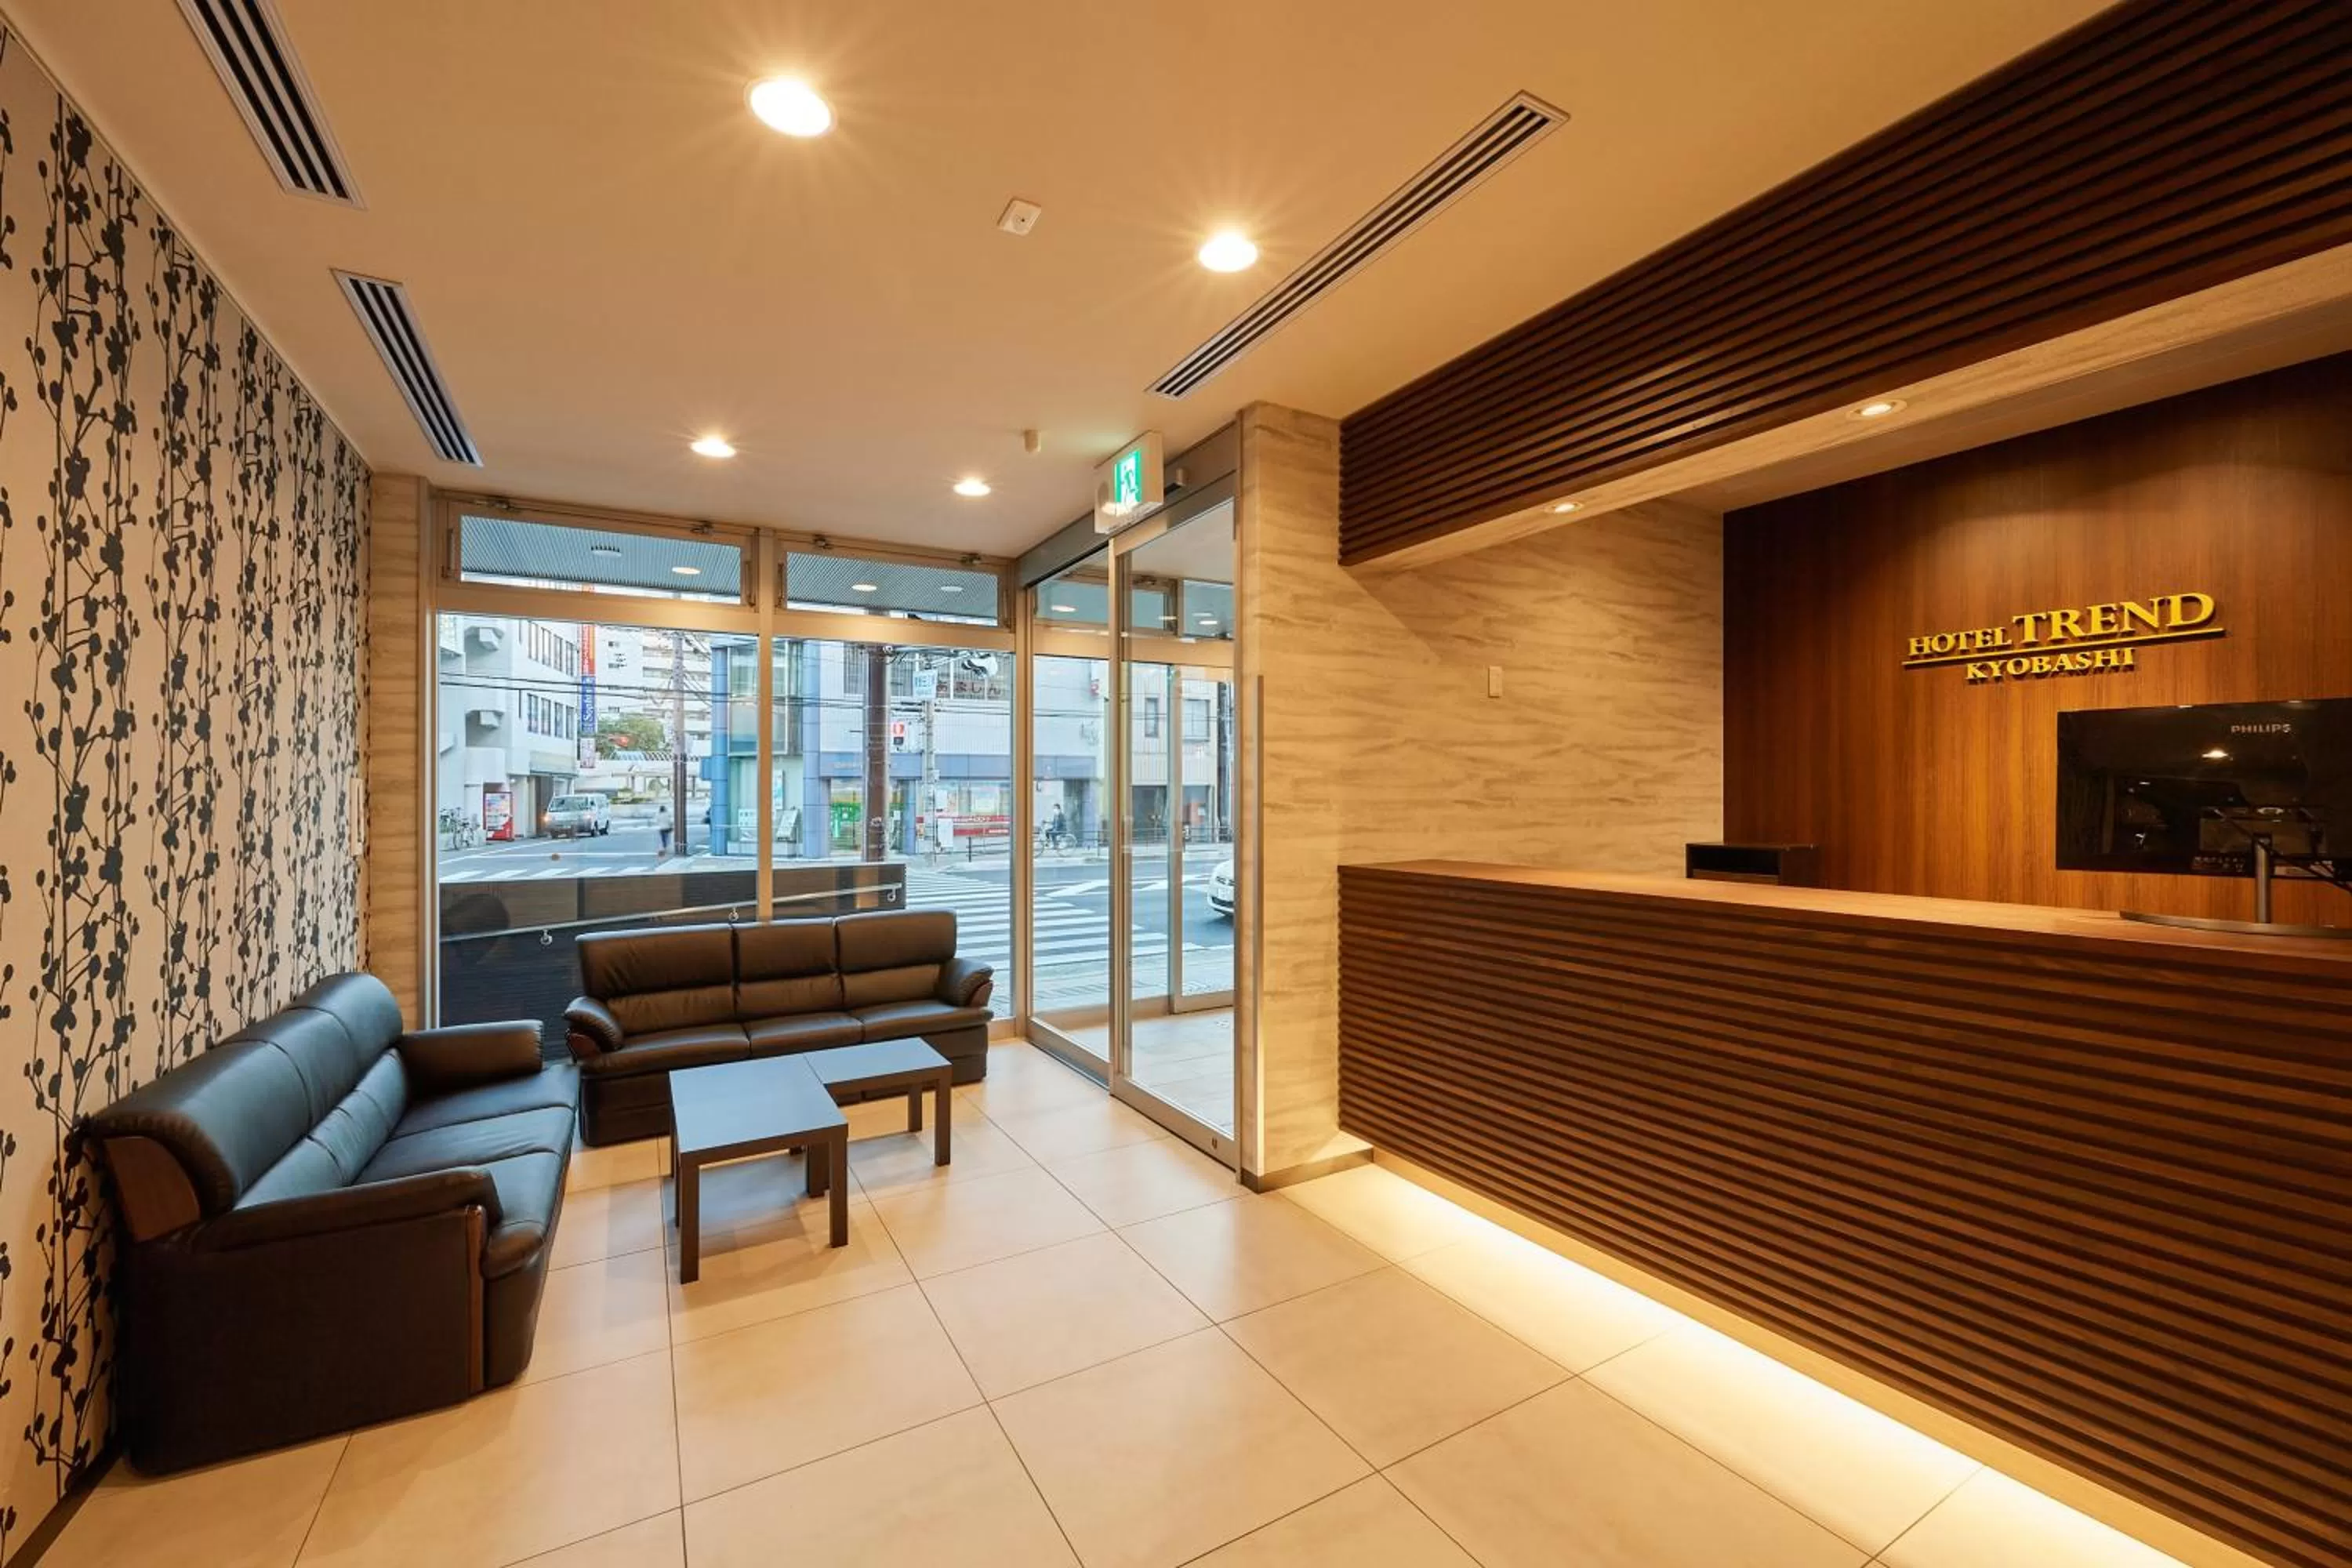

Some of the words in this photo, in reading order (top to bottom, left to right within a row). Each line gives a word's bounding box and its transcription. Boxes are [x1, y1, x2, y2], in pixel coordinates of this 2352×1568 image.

[1908, 627, 2012, 656] HOTEL
[2013, 593, 2216, 644] TREND
[1965, 648, 2136, 680] KYOBASHI
[2230, 724, 2292, 733] PHILIPS
